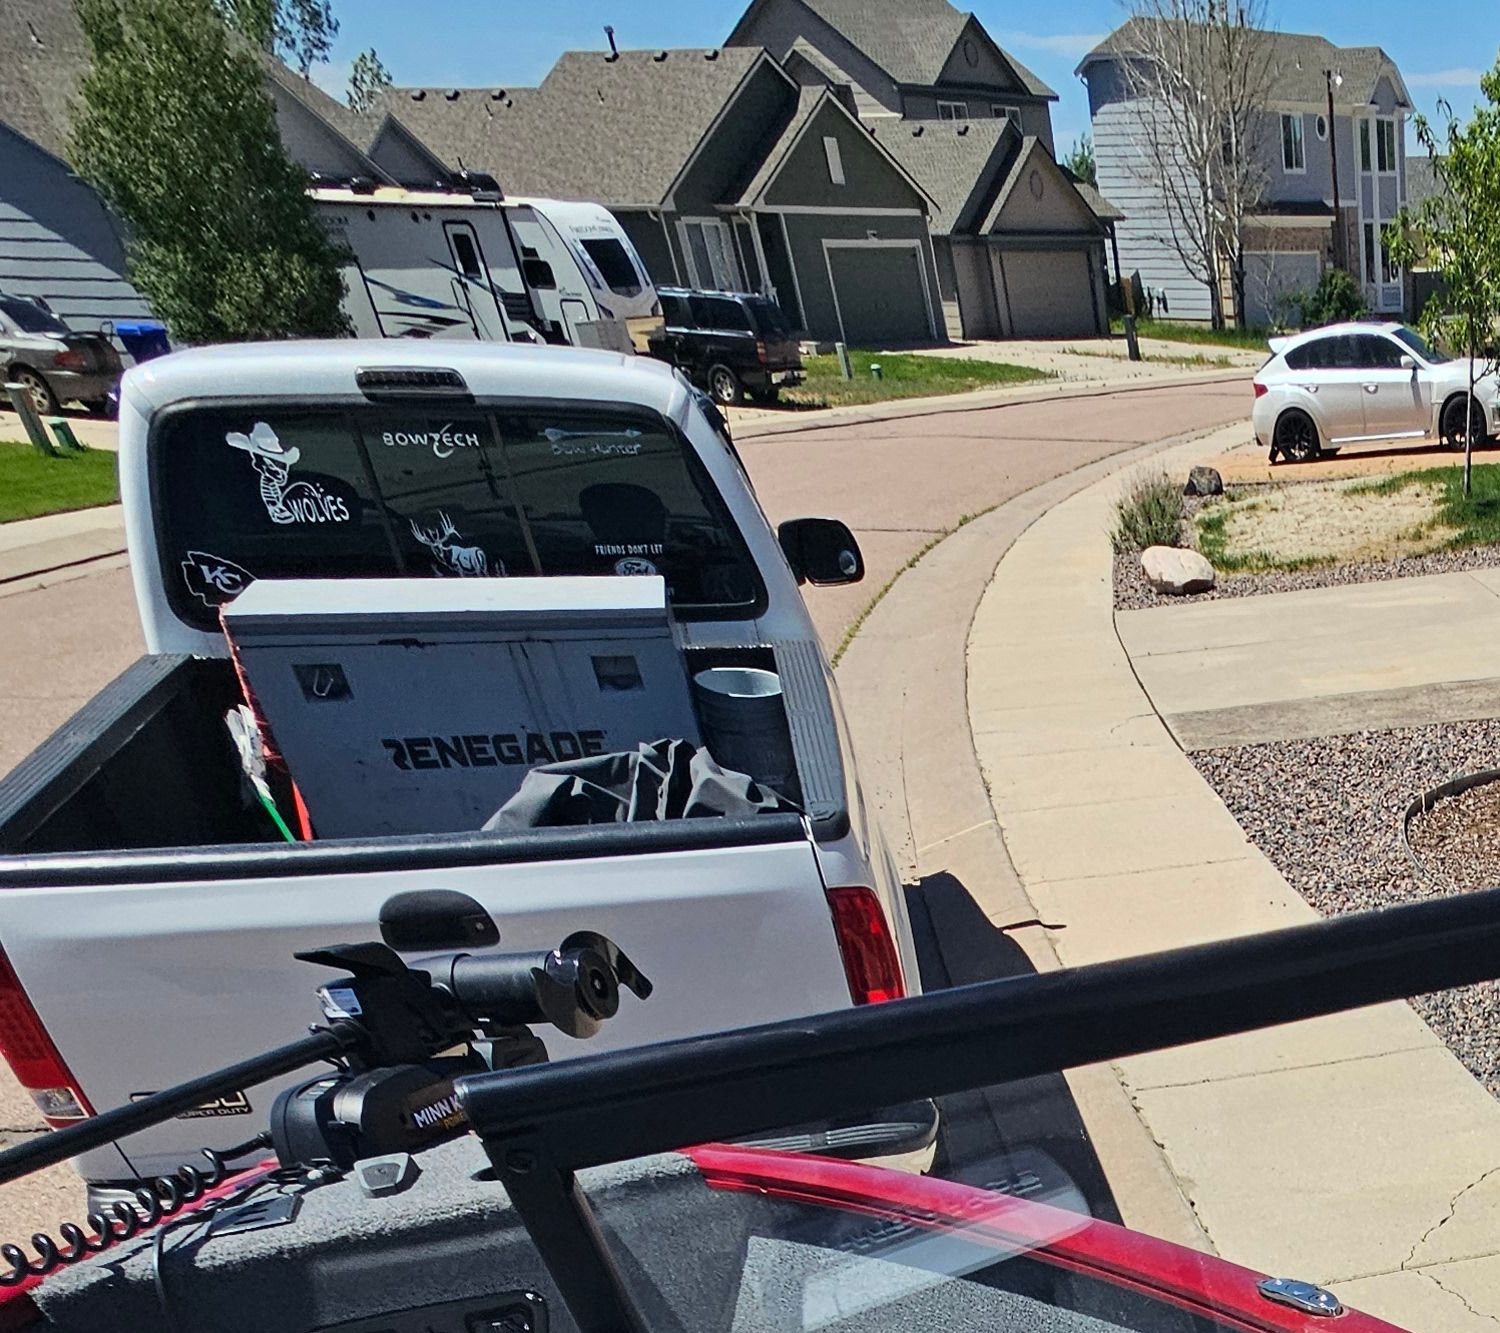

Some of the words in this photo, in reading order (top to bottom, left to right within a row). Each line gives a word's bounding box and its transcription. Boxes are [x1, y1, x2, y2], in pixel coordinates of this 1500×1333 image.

[382, 429, 480, 455] BOWTECH
[288, 498, 350, 522] WOLVES
[595, 544, 625, 554] FRIENDS
[628, 544, 648, 554] DON'T
[650, 544, 662, 554] LET
[380, 730, 609, 770] RENEGADE
[218, 1106, 248, 1114] DUTY
[414, 1098, 452, 1128] MINN
